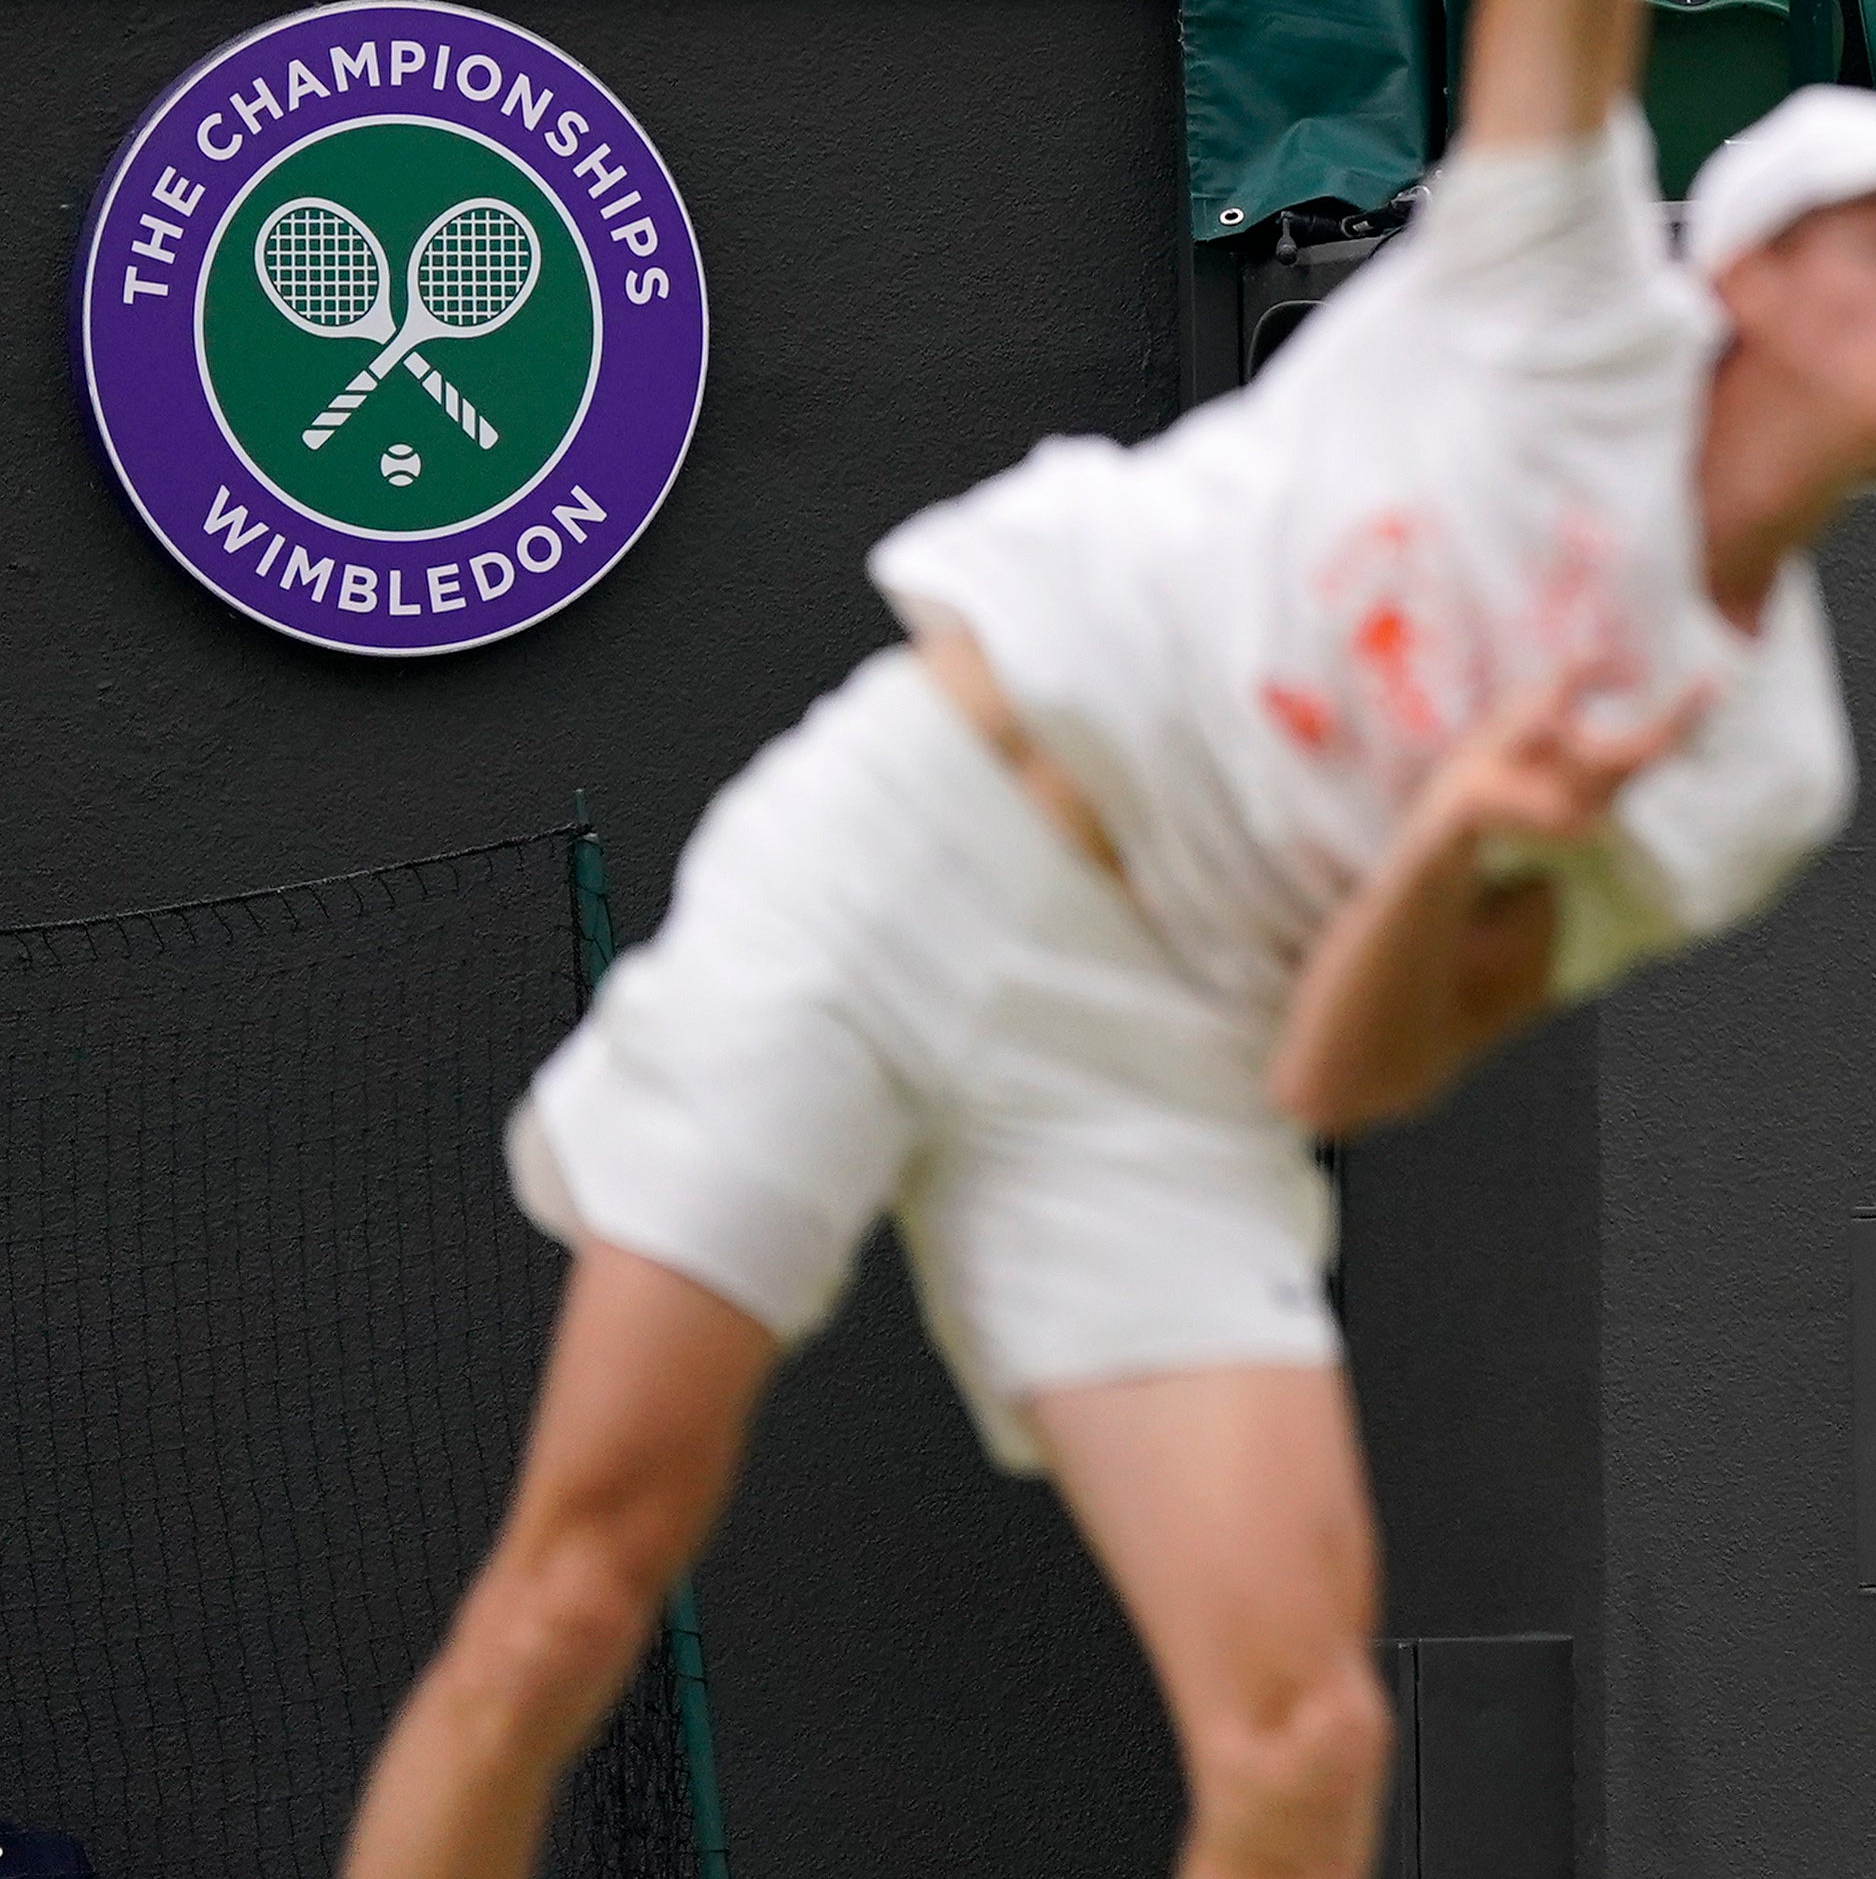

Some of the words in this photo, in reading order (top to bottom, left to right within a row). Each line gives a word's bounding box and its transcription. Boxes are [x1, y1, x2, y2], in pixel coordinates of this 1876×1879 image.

[124, 166, 205, 304] THE
[197, 40, 669, 305] CHAMPIONSHIPS
[203, 485, 607, 615] WIMBLEDON
